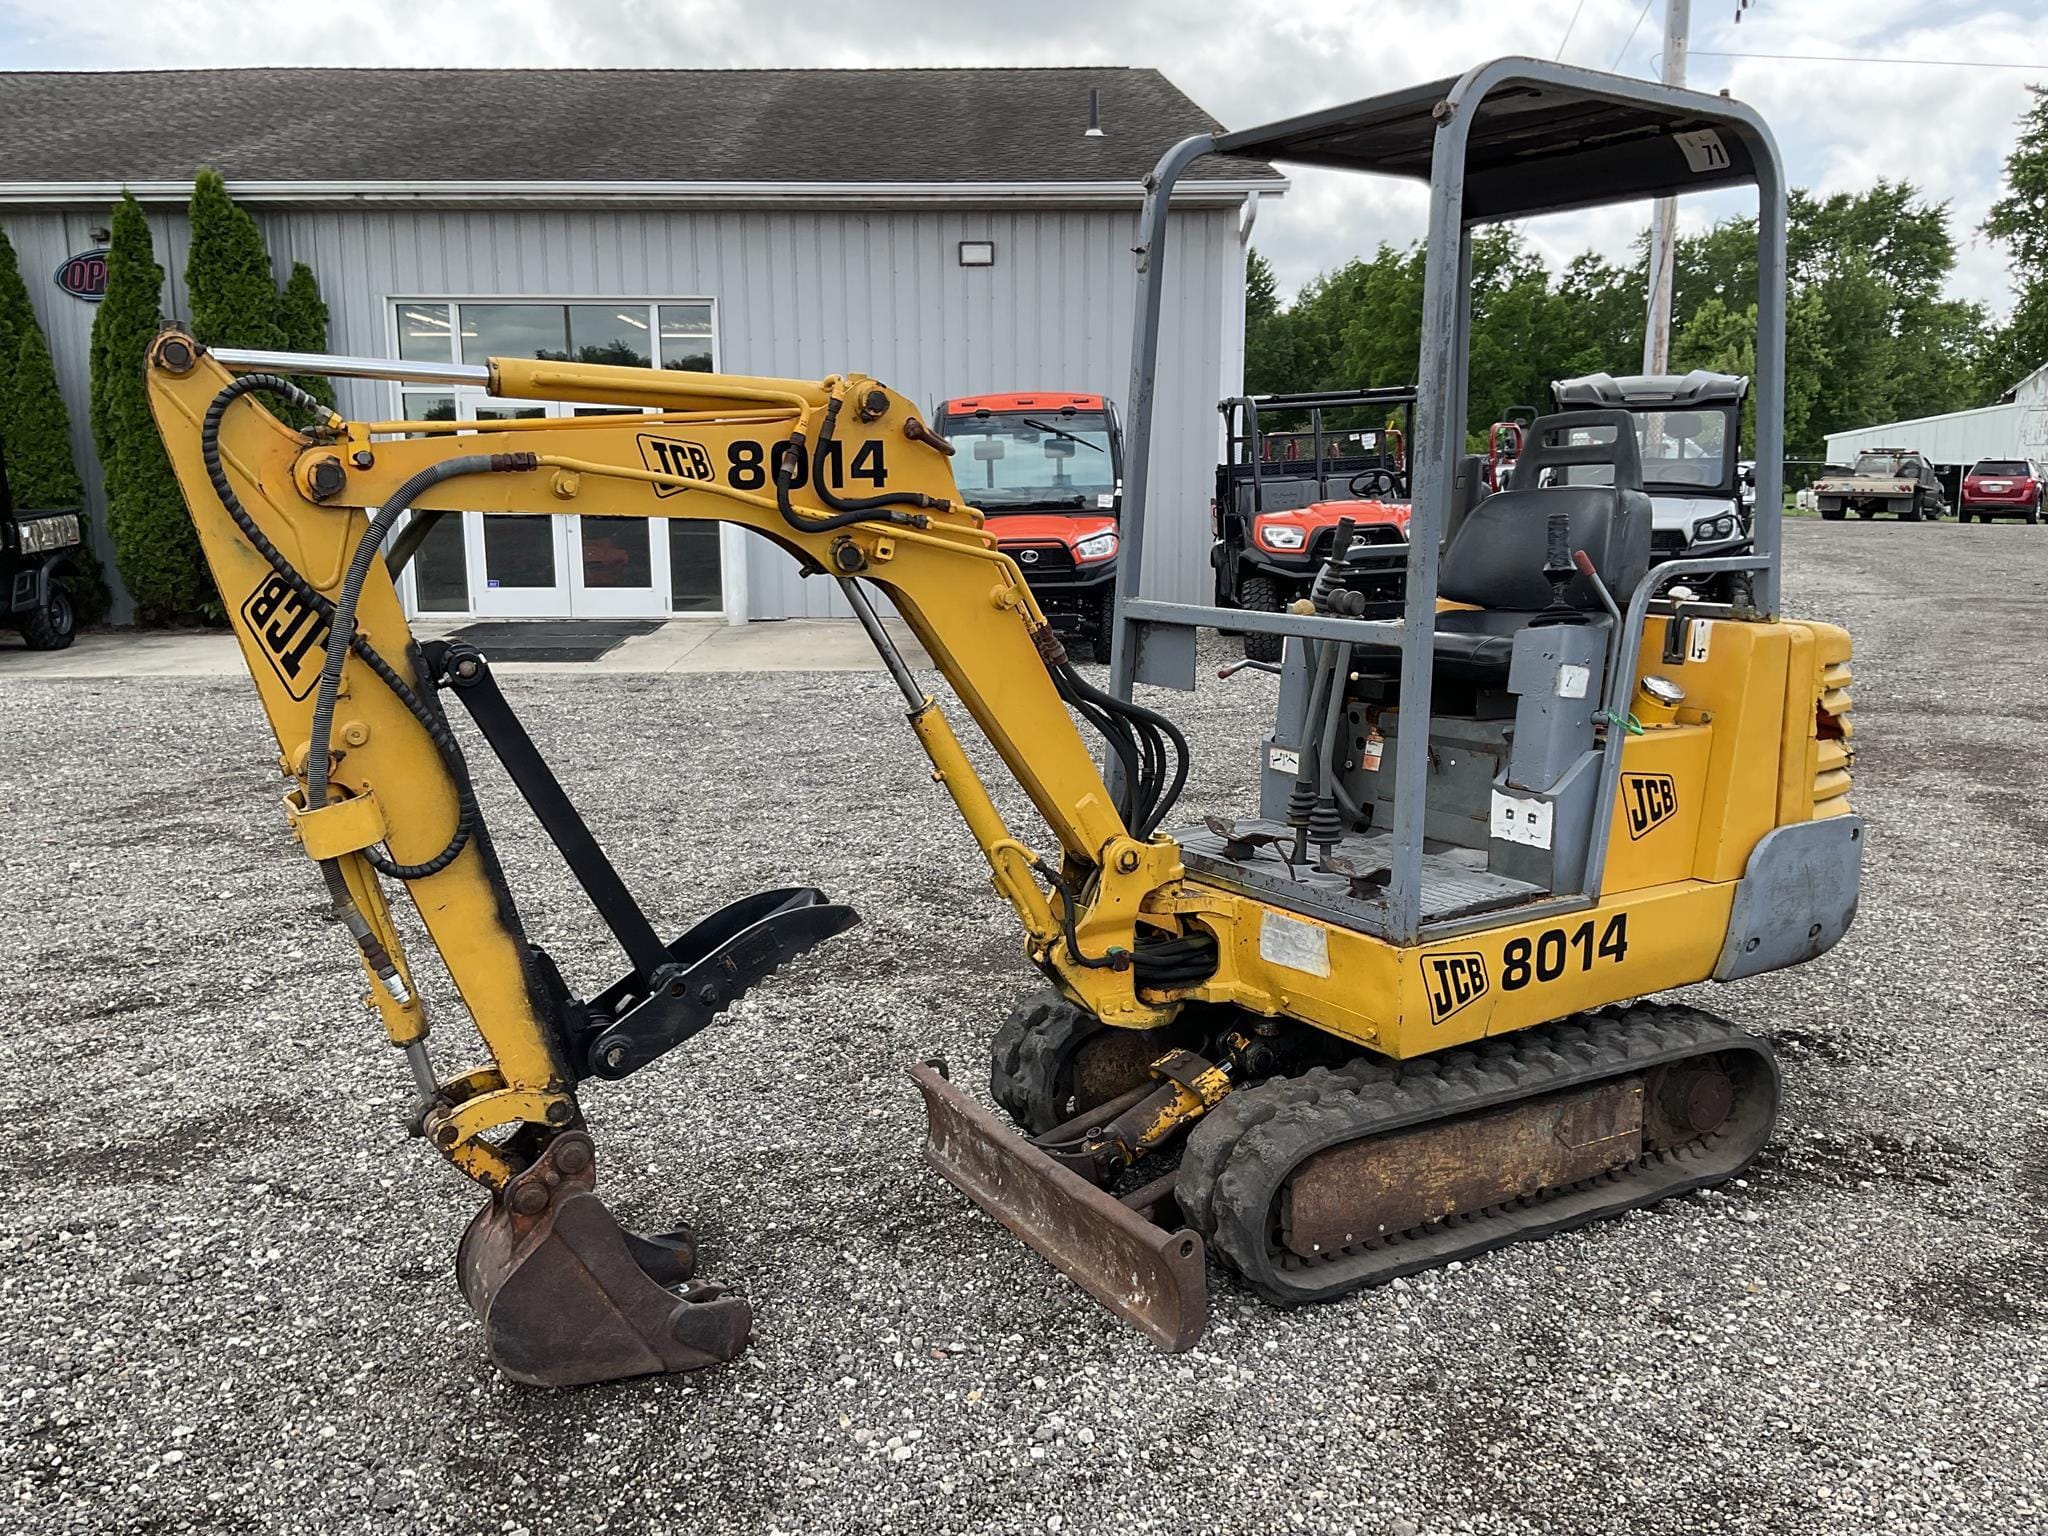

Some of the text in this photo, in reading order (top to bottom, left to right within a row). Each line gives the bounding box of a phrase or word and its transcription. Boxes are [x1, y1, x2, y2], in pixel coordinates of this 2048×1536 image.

[1701, 143, 1725, 166] 71
[67, 260, 110, 292] OP
[650, 439, 888, 491] JCB 8014
[250, 577, 338, 680] JCB
[1631, 778, 1675, 832] JCB
[1432, 912, 1628, 1017] JCB 8014
